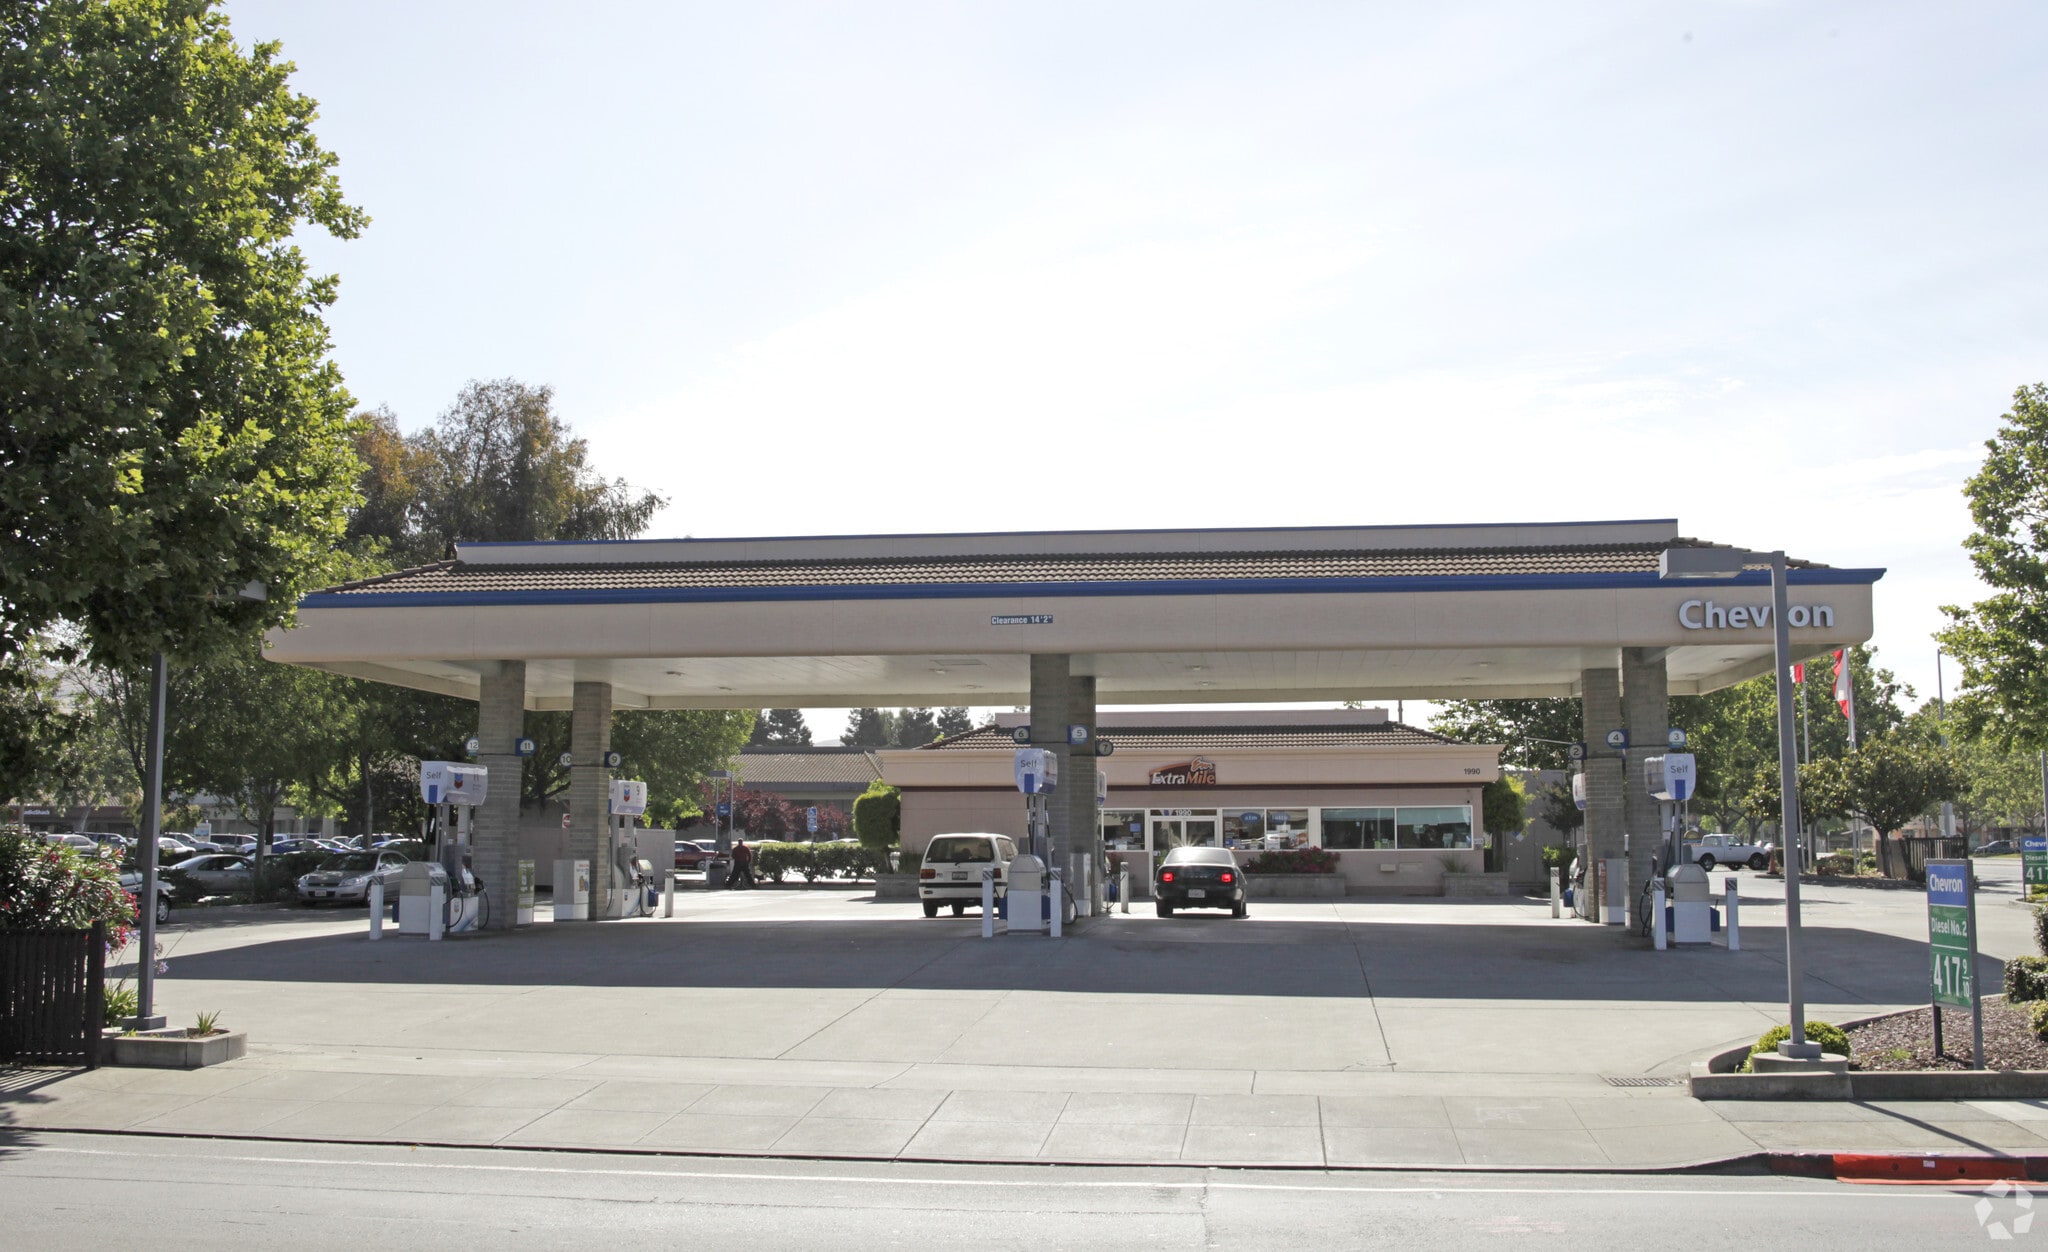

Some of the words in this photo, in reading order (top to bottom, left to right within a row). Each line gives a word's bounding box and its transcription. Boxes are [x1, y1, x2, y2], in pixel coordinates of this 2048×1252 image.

[1679, 600, 1834, 629] Chevon
[991, 616, 1028, 625] Clearance
[1076, 729, 1083, 737] 5
[1613, 733, 1620, 741] 4
[1674, 732, 1680, 741] 3
[470, 741, 479, 749] 12
[524, 741, 531, 749] 11
[1103, 744, 1109, 752] 7
[1573, 747, 1580, 756] 2
[562, 755, 572, 764] 10
[612, 755, 618, 764] 9
[1020, 759, 1037, 768] Self
[1463, 767, 1481, 776] 1990
[1670, 765, 1689, 774] Self
[426, 771, 442, 780] Self
[2024, 840, 2047, 848] Chevr
[1929, 873, 1963, 893] Chevron
[1931, 917, 1950, 934] Diesel
[1950, 919, 1962, 936] No.
[1962, 921, 1968, 936] 2
[1962, 958, 1968, 974] 9
[1933, 954, 1961, 997] 417
[1962, 980, 1970, 998] 10
